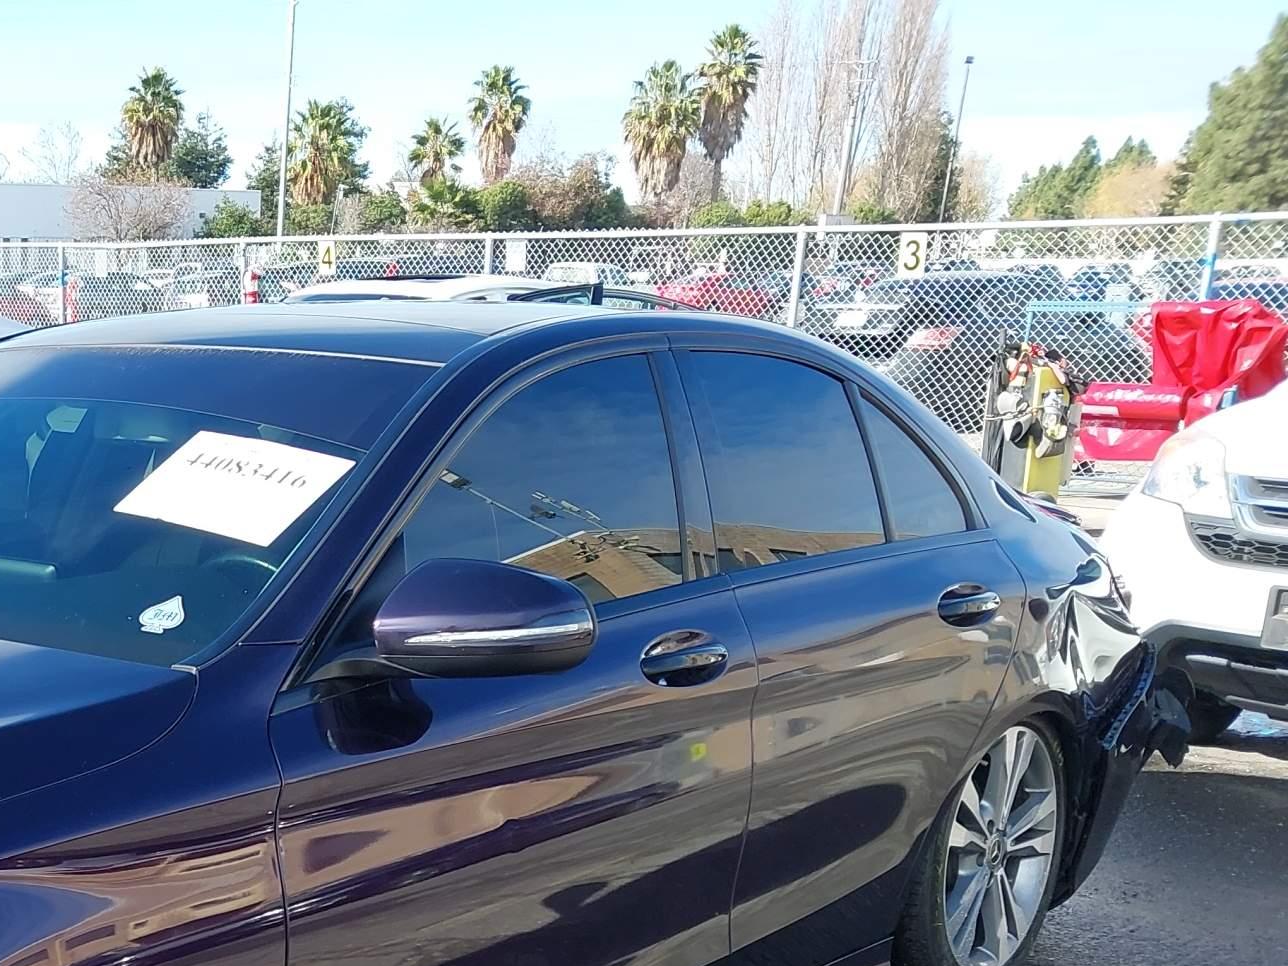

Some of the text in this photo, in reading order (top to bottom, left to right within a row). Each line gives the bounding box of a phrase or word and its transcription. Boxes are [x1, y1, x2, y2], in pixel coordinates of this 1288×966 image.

[321, 246, 333, 269] 4
[903, 240, 920, 271] 3
[186, 453, 307, 488] 44083416
